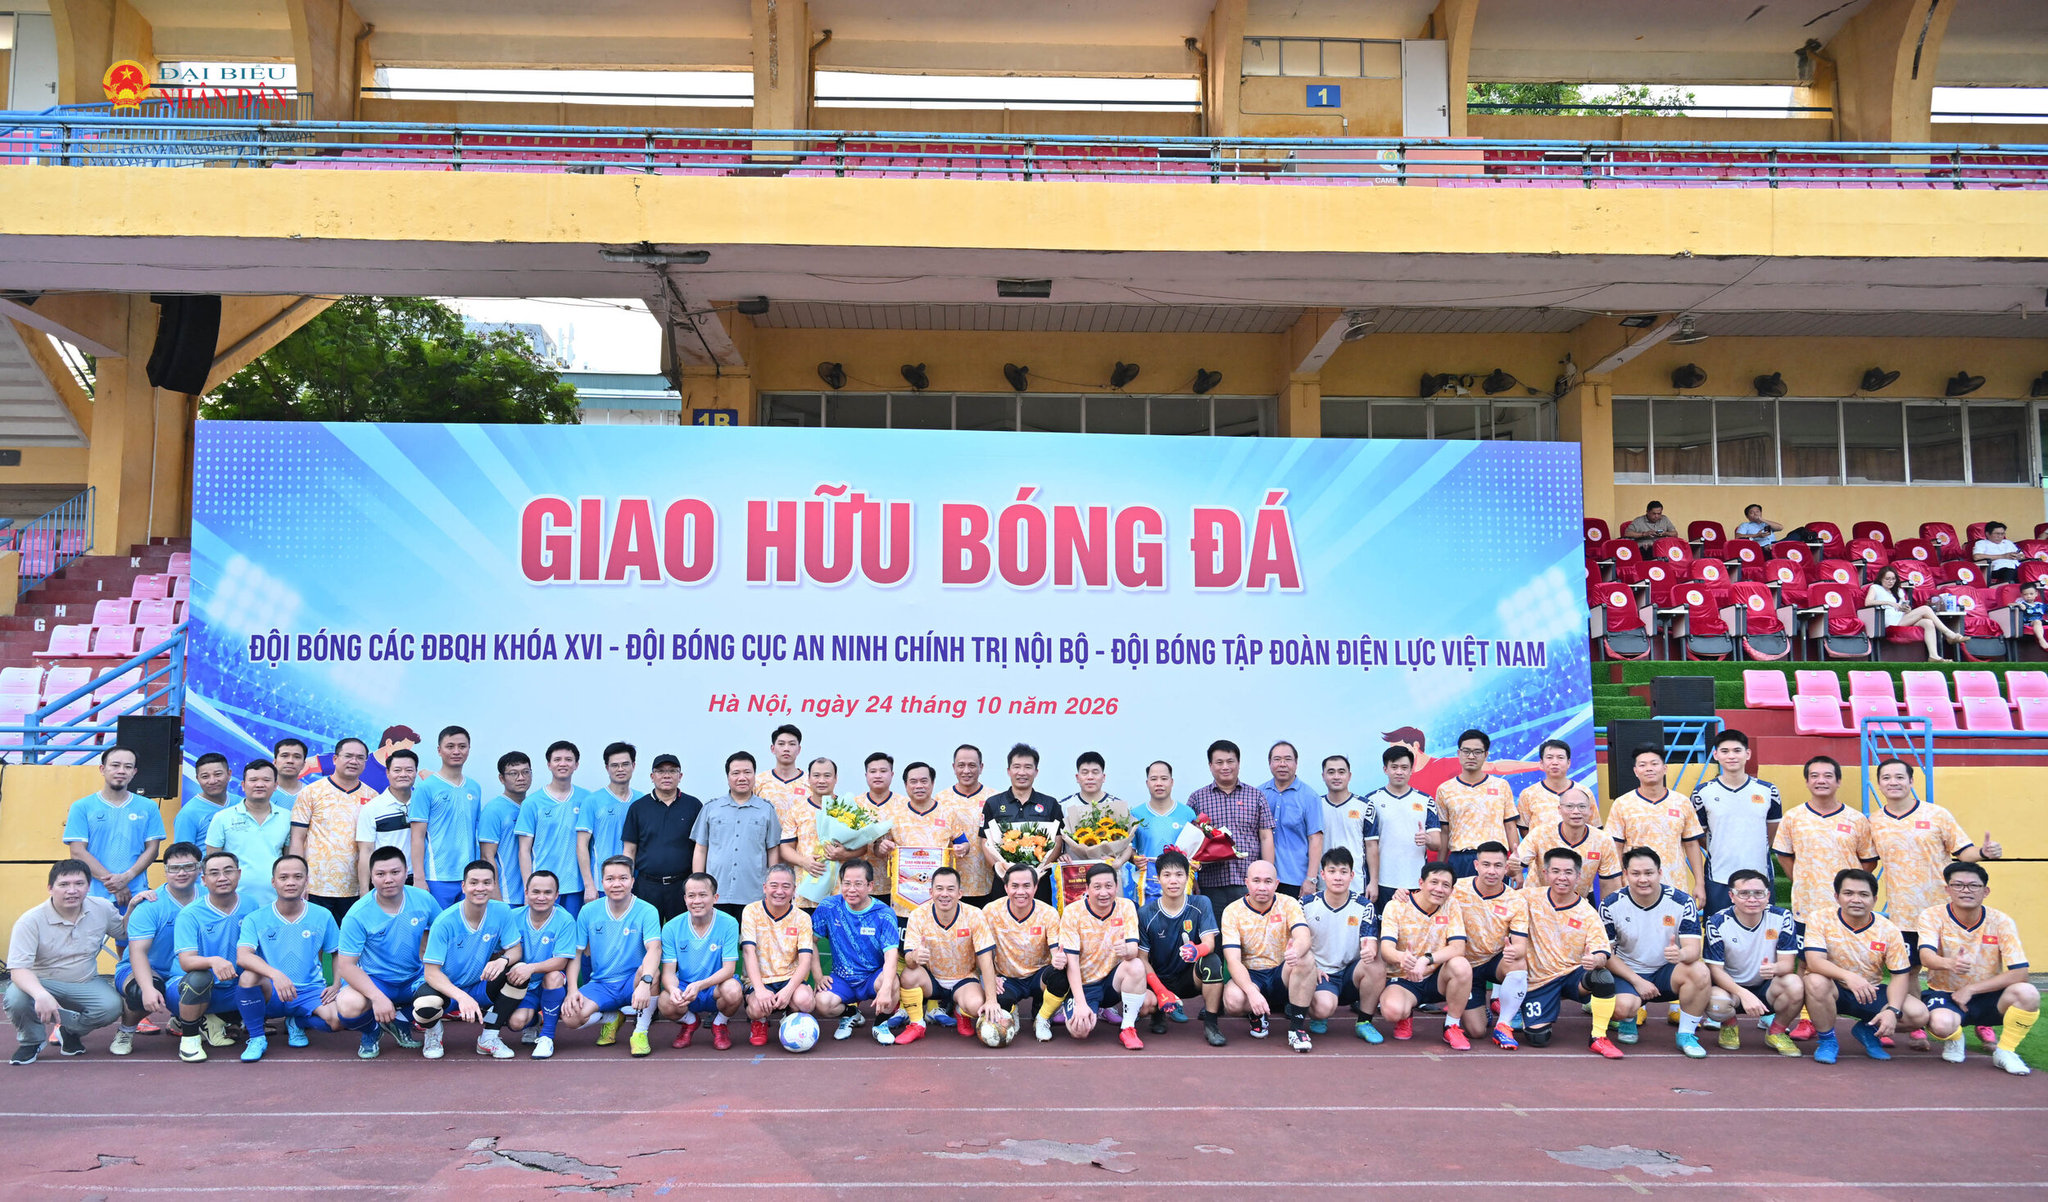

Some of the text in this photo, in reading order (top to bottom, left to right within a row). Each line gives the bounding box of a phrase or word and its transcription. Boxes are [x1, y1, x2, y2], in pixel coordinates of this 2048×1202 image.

[1318, 88, 1328, 105] 1
[519, 483, 1301, 589] GIAO HỮU BÓNG ĐÁ
[131, 556, 141, 568] K
[55, 605, 67, 617] H
[34, 618, 46, 632] G
[249, 628, 289, 667] ĐỘI
[297, 628, 362, 661] BÓNG
[369, 628, 415, 661] CÁC
[421, 634, 486, 663] ĐBQH
[493, 628, 558, 660] KHÓA
[564, 634, 602, 660] XVI
[626, 628, 665, 666] ĐỘI
[672, 628, 735, 661] BÓNG
[742, 634, 787, 667] CỤC
[793, 634, 825, 661] AN
[832, 635, 887, 662] NINH
[895, 630, 964, 663] CHÍNH
[971, 636, 1008, 669] TRỊ
[1015, 631, 1052, 670] NỘI
[1060, 632, 1089, 670] BỘ
[1111, 632, 1149, 670] ĐỘI
[1156, 633, 1216, 665] BÓNG
[1222, 634, 1263, 671] TẬP
[1269, 634, 1330, 666] ĐOÀN
[1336, 634, 1388, 671] ĐIỆN
[1395, 637, 1436, 671] LỰC
[1442, 635, 1490, 672] VIỆT
[1496, 641, 1546, 667] NAM
[708, 693, 1119, 719] Hà Nội, ngày 24 tháng 10 năm 2026
[1525, 1001, 1542, 1018] 33
